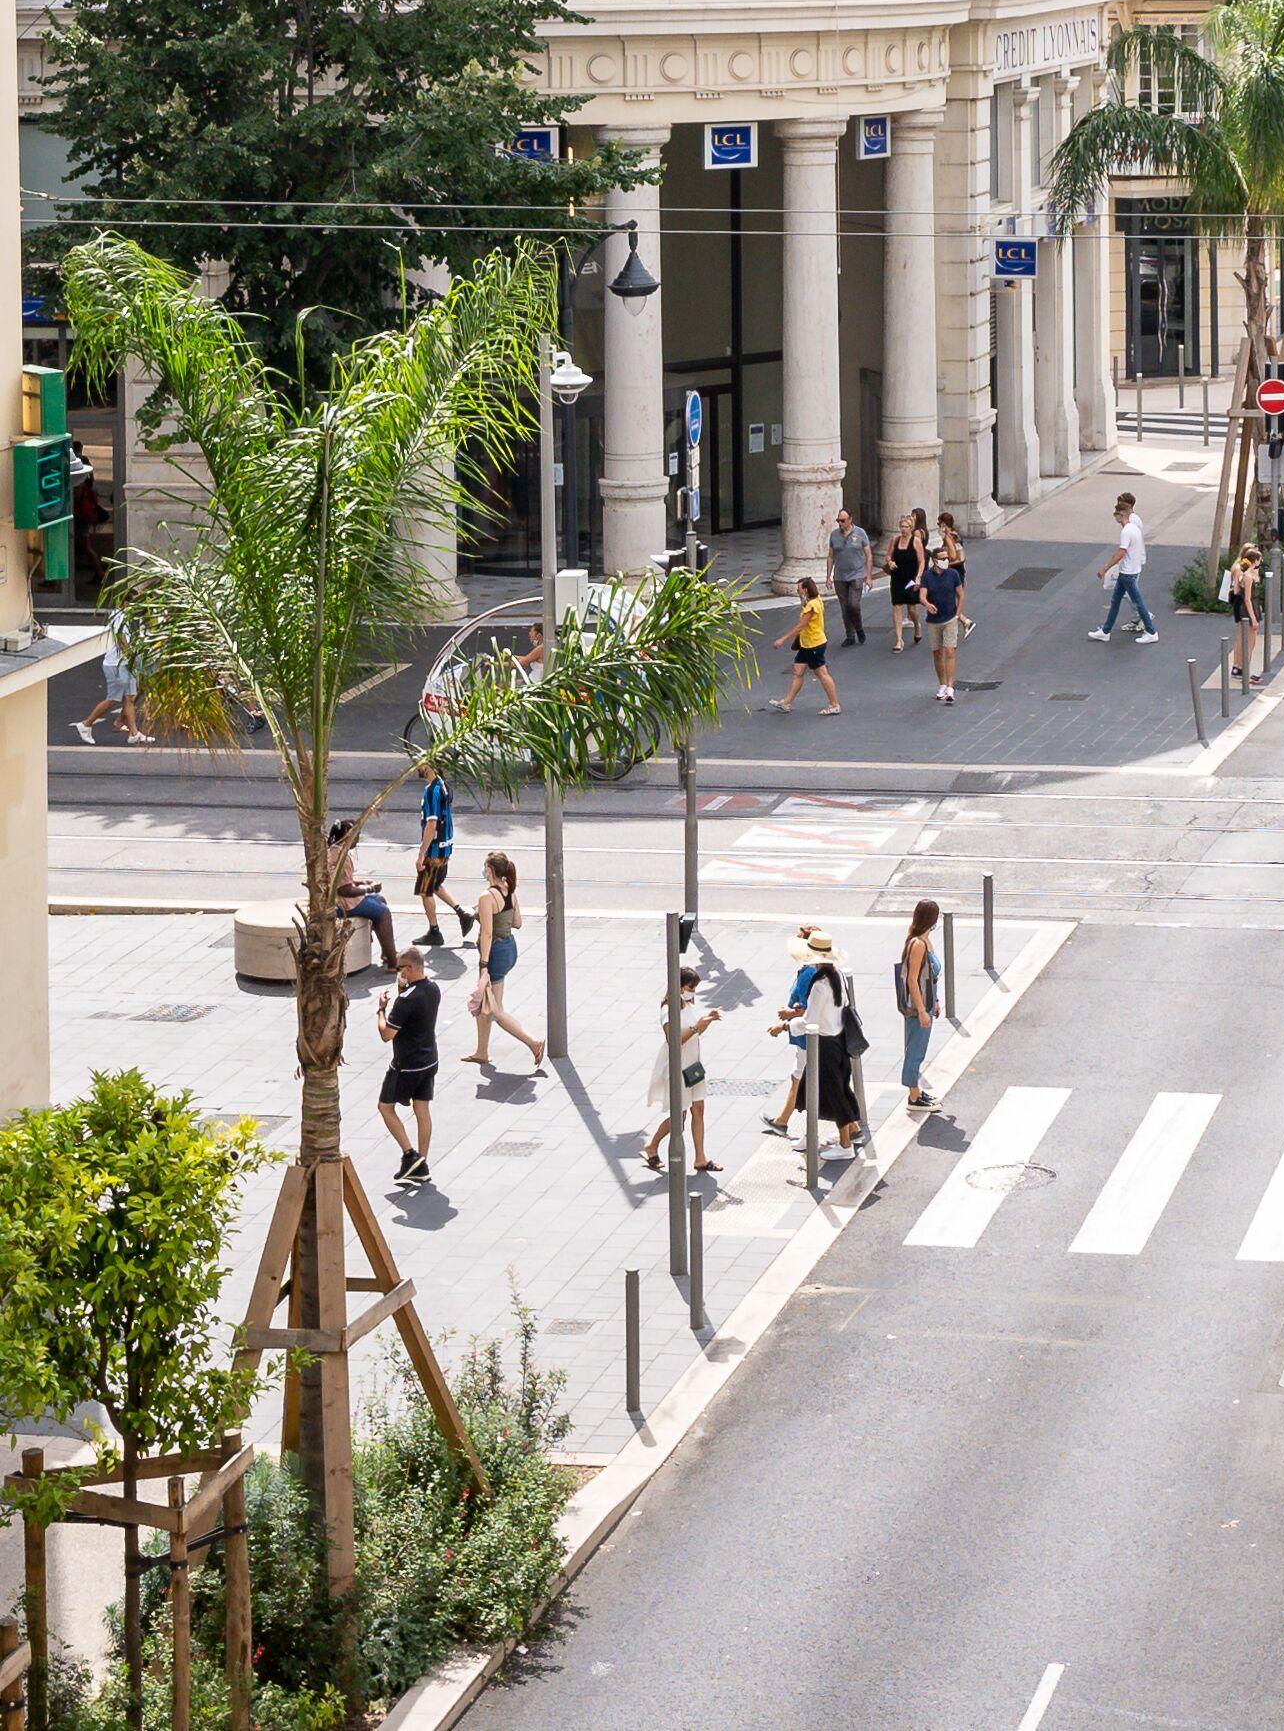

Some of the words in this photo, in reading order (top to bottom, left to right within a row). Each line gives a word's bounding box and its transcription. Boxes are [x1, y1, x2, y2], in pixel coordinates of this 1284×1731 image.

[995, 28, 1037, 71] CREDIT
[1043, 19, 1097, 62] LYONNAIS
[864, 125, 885, 138] LCL
[714, 133, 746, 147] LCL
[998, 247, 1032, 260] LCL
